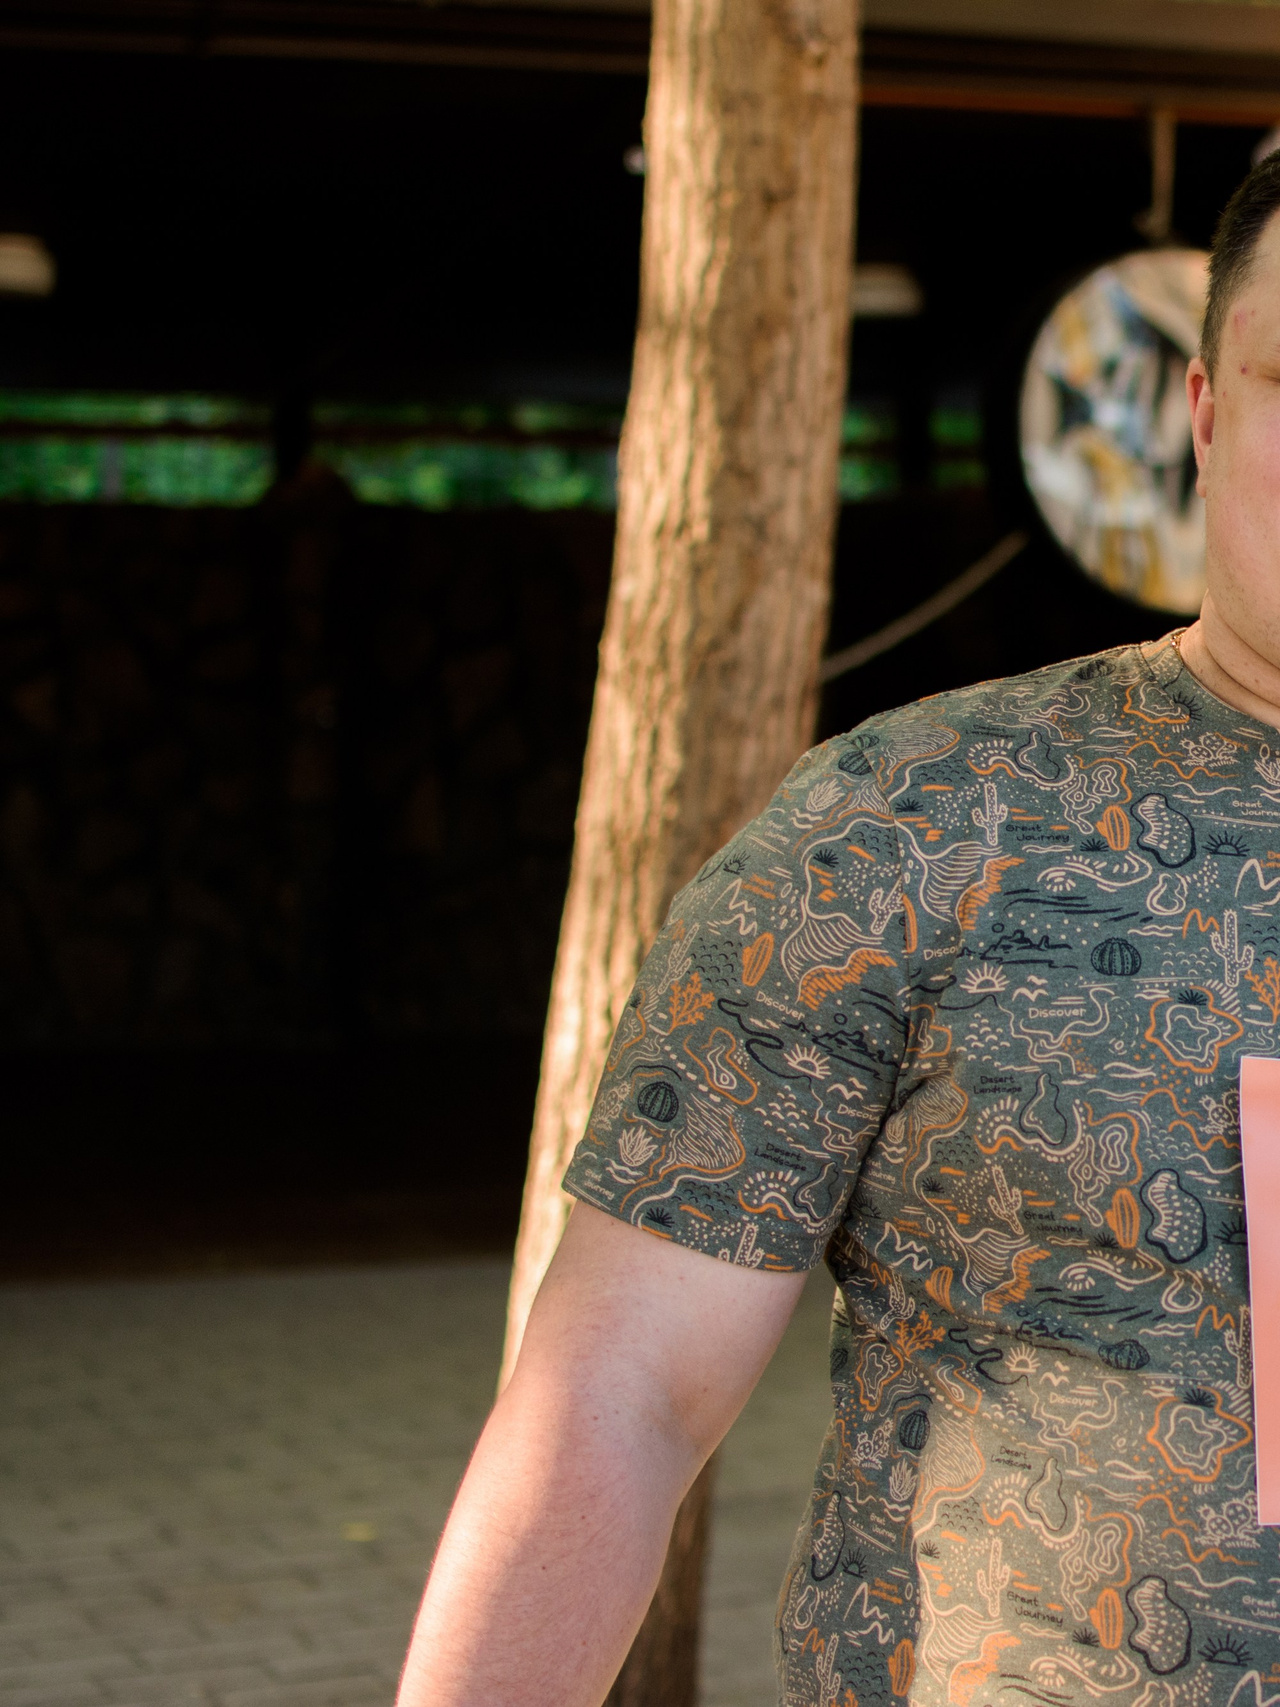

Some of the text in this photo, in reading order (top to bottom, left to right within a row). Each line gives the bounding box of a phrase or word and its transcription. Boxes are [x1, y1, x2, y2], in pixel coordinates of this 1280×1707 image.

[1232, 800, 1262, 809] Great
[1005, 823, 1042, 832] Great
[1016, 833, 1070, 844] Journey
[923, 945, 958, 961] Disco
[755, 990, 805, 1020] Discover
[1028, 1007, 1086, 1019] Discover
[980, 1075, 1015, 1084] Desert
[766, 1143, 803, 1161] Desert
[754, 1149, 807, 1171] Landscape
[1024, 1210, 1056, 1221] Great
[1036, 1224, 1084, 1236] Journey
[1049, 1392, 1098, 1407] Discover
[1000, 1446, 1028, 1459] Desert
[1006, 1590, 1039, 1606] Great
[1242, 1595, 1278, 1608] Great
[1014, 1606, 1064, 1628] Journey
